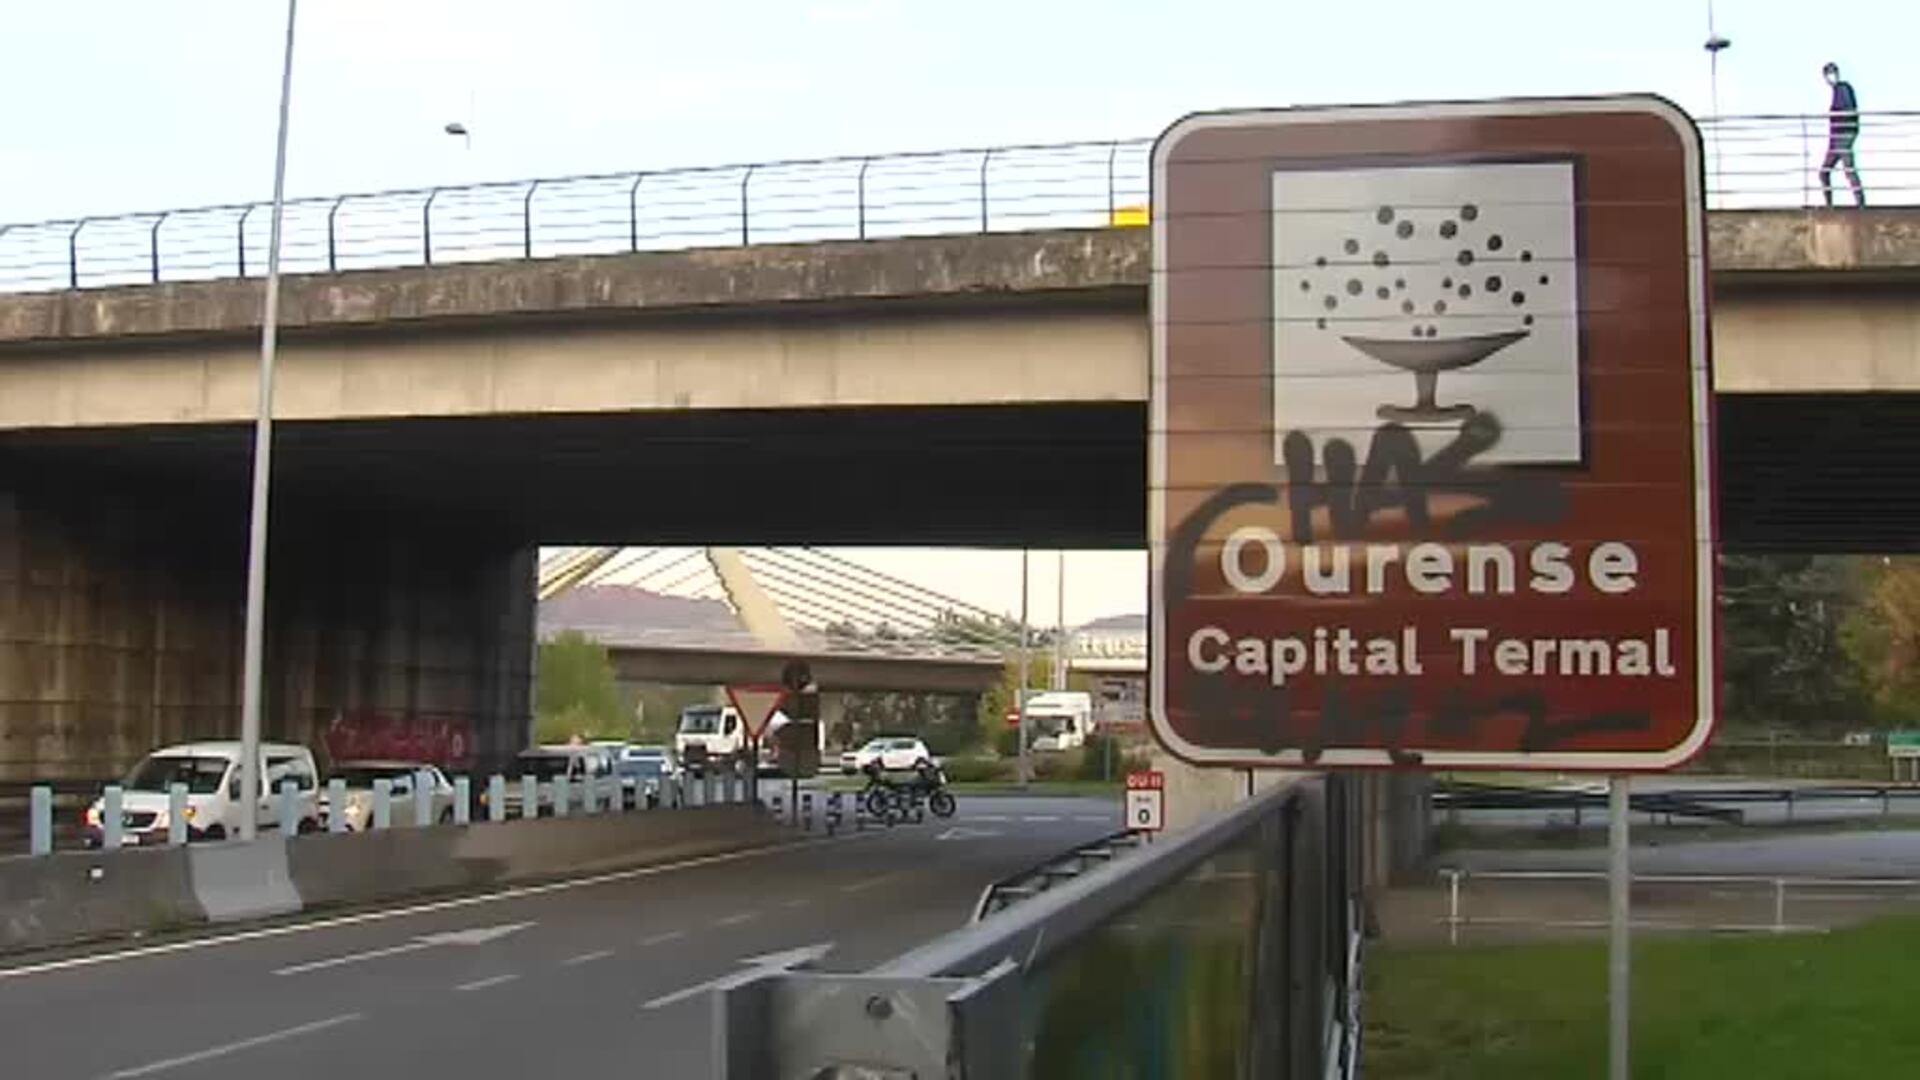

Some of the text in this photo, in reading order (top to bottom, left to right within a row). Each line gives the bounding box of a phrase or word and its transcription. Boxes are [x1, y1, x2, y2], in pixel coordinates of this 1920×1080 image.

[1220, 525, 1639, 594] Ourense
[1188, 627, 1677, 685] Capital Termal
[1138, 809, 1150, 824] 0
